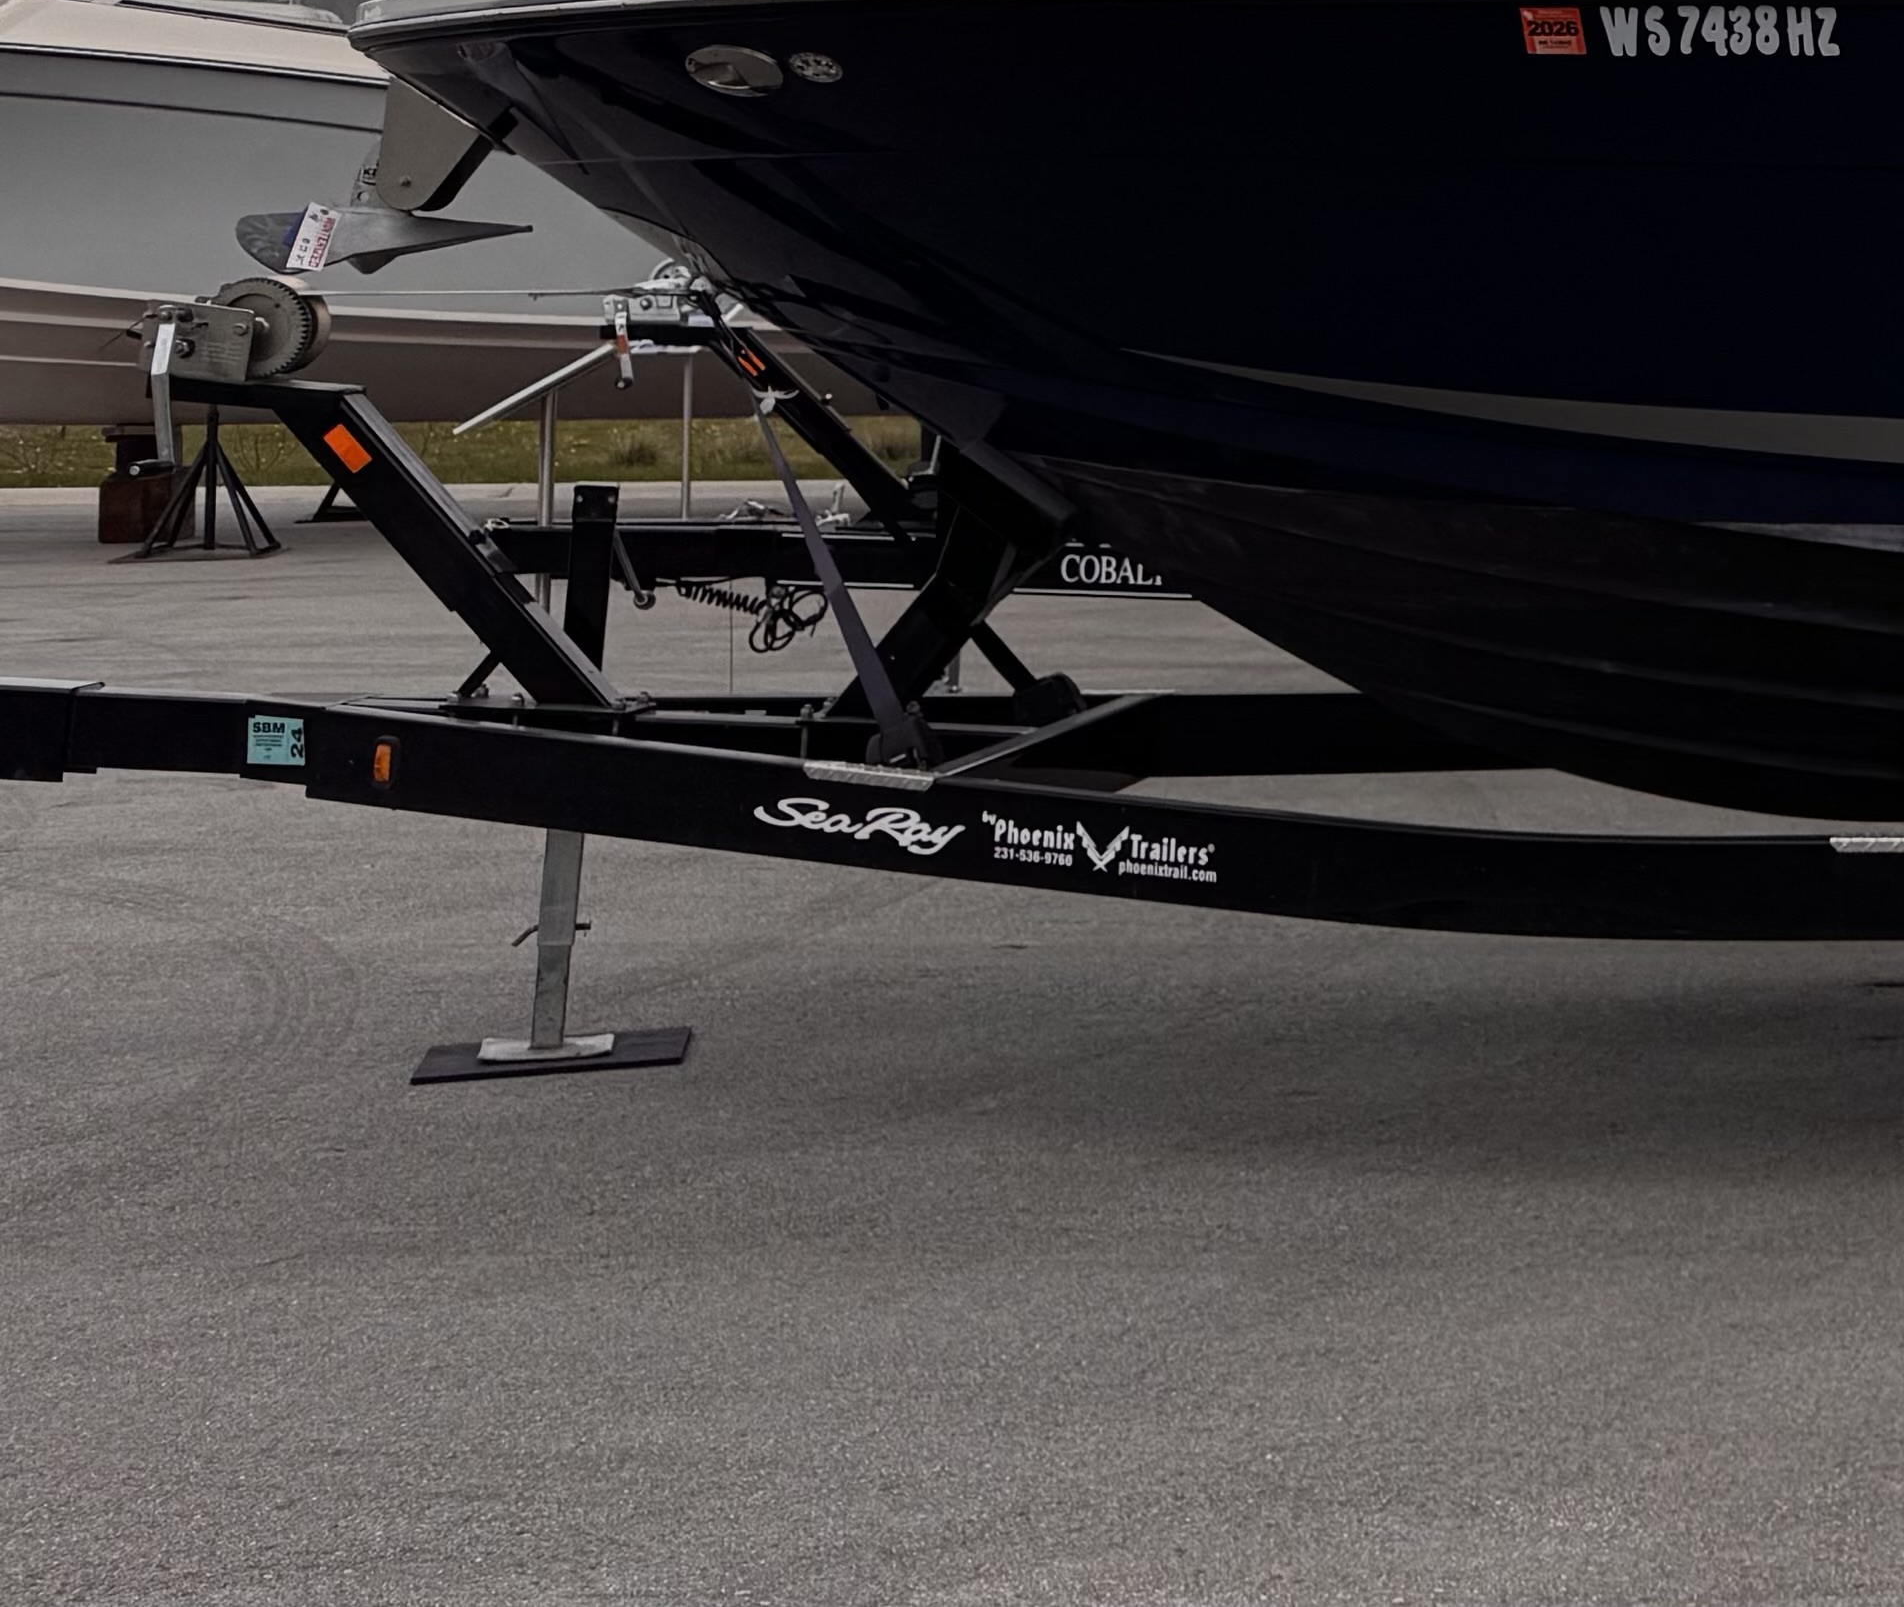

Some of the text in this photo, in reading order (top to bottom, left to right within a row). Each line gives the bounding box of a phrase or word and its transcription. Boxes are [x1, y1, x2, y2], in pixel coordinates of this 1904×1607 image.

[1527, 20, 1580, 37] 2026
[1599, 5, 1841, 57] WS 7438 HZ
[290, 727, 304, 758] 24
[753, 797, 966, 855] Sea Ray
[994, 818, 1075, 850] Phoenix
[1118, 859, 1217, 883] phoenixtrail.com
